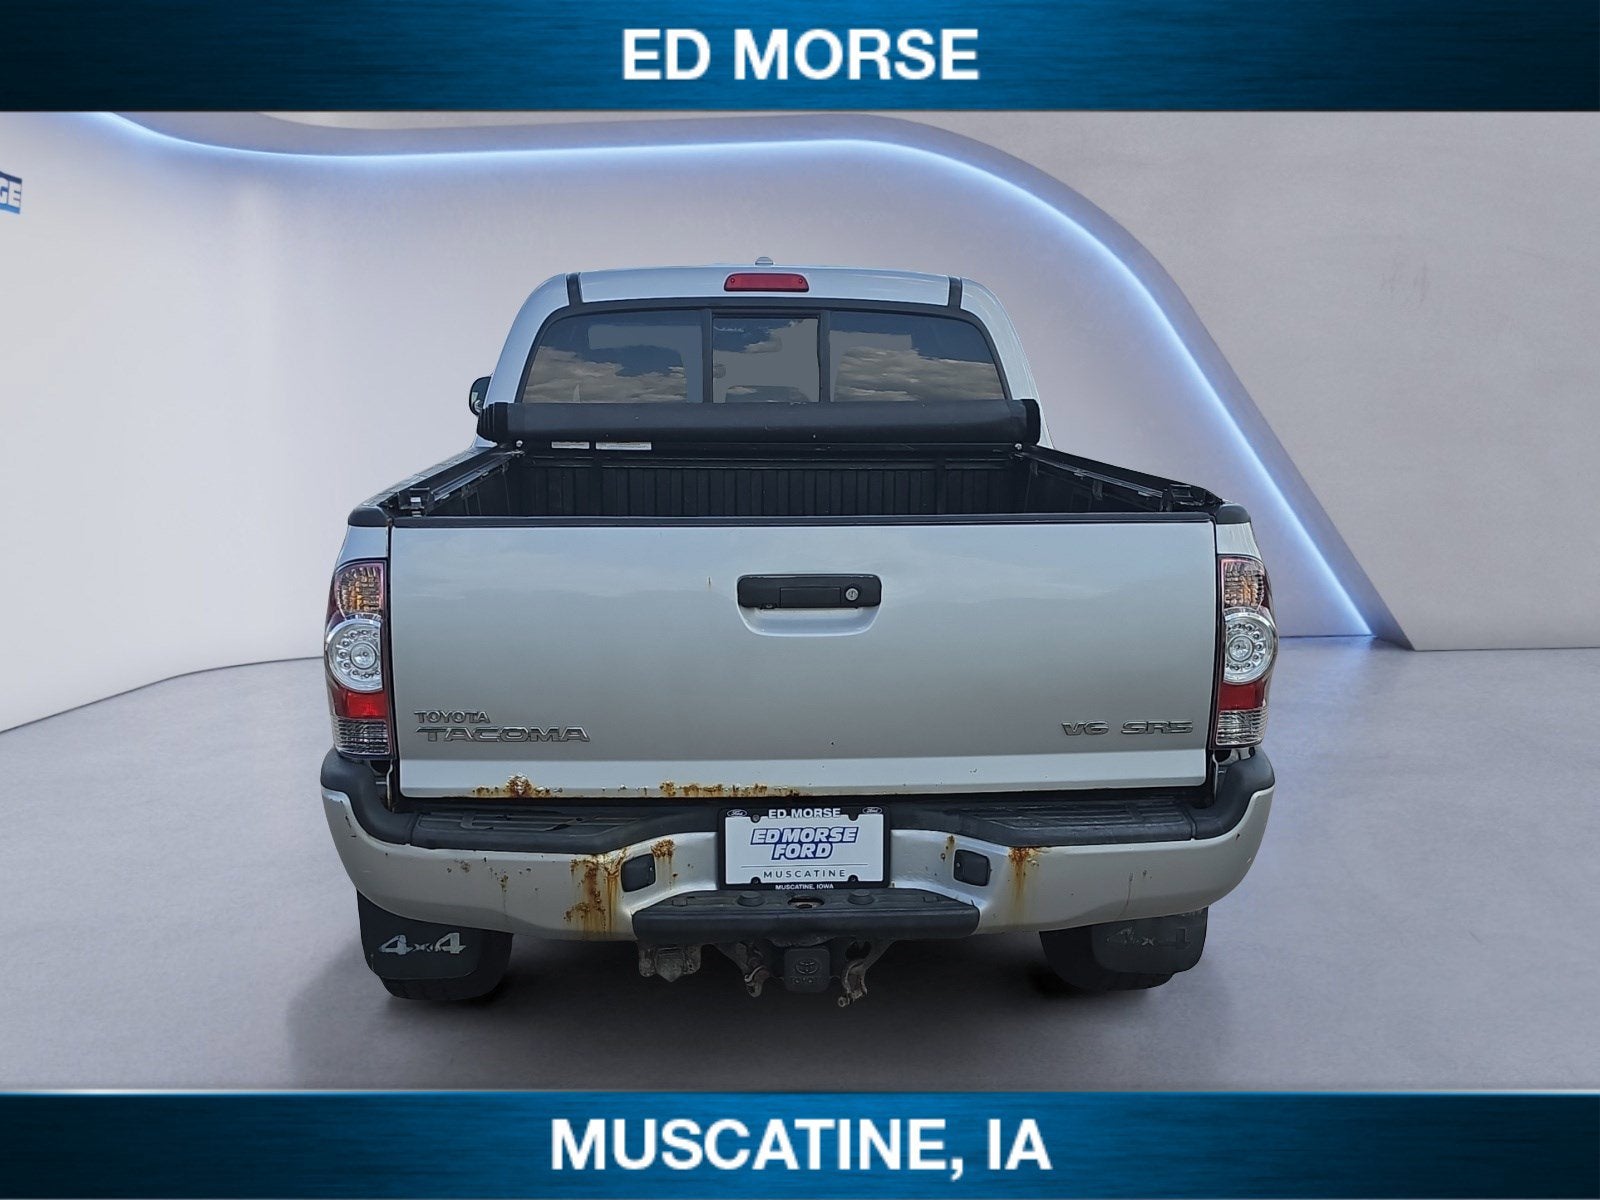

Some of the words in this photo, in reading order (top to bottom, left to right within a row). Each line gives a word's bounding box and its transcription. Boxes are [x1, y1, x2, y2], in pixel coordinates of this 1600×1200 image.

[413, 710, 490, 723] TOYOTA
[416, 726, 590, 742] TACOMA
[1061, 720, 1109, 736] V6
[1120, 720, 1193, 734] SR5
[768, 809, 787, 819] ED
[791, 808, 841, 819] MORSE
[750, 828, 782, 845] ED
[781, 826, 859, 844] MORSE
[771, 842, 833, 860] FORD
[763, 869, 846, 878] MUSCATINE
